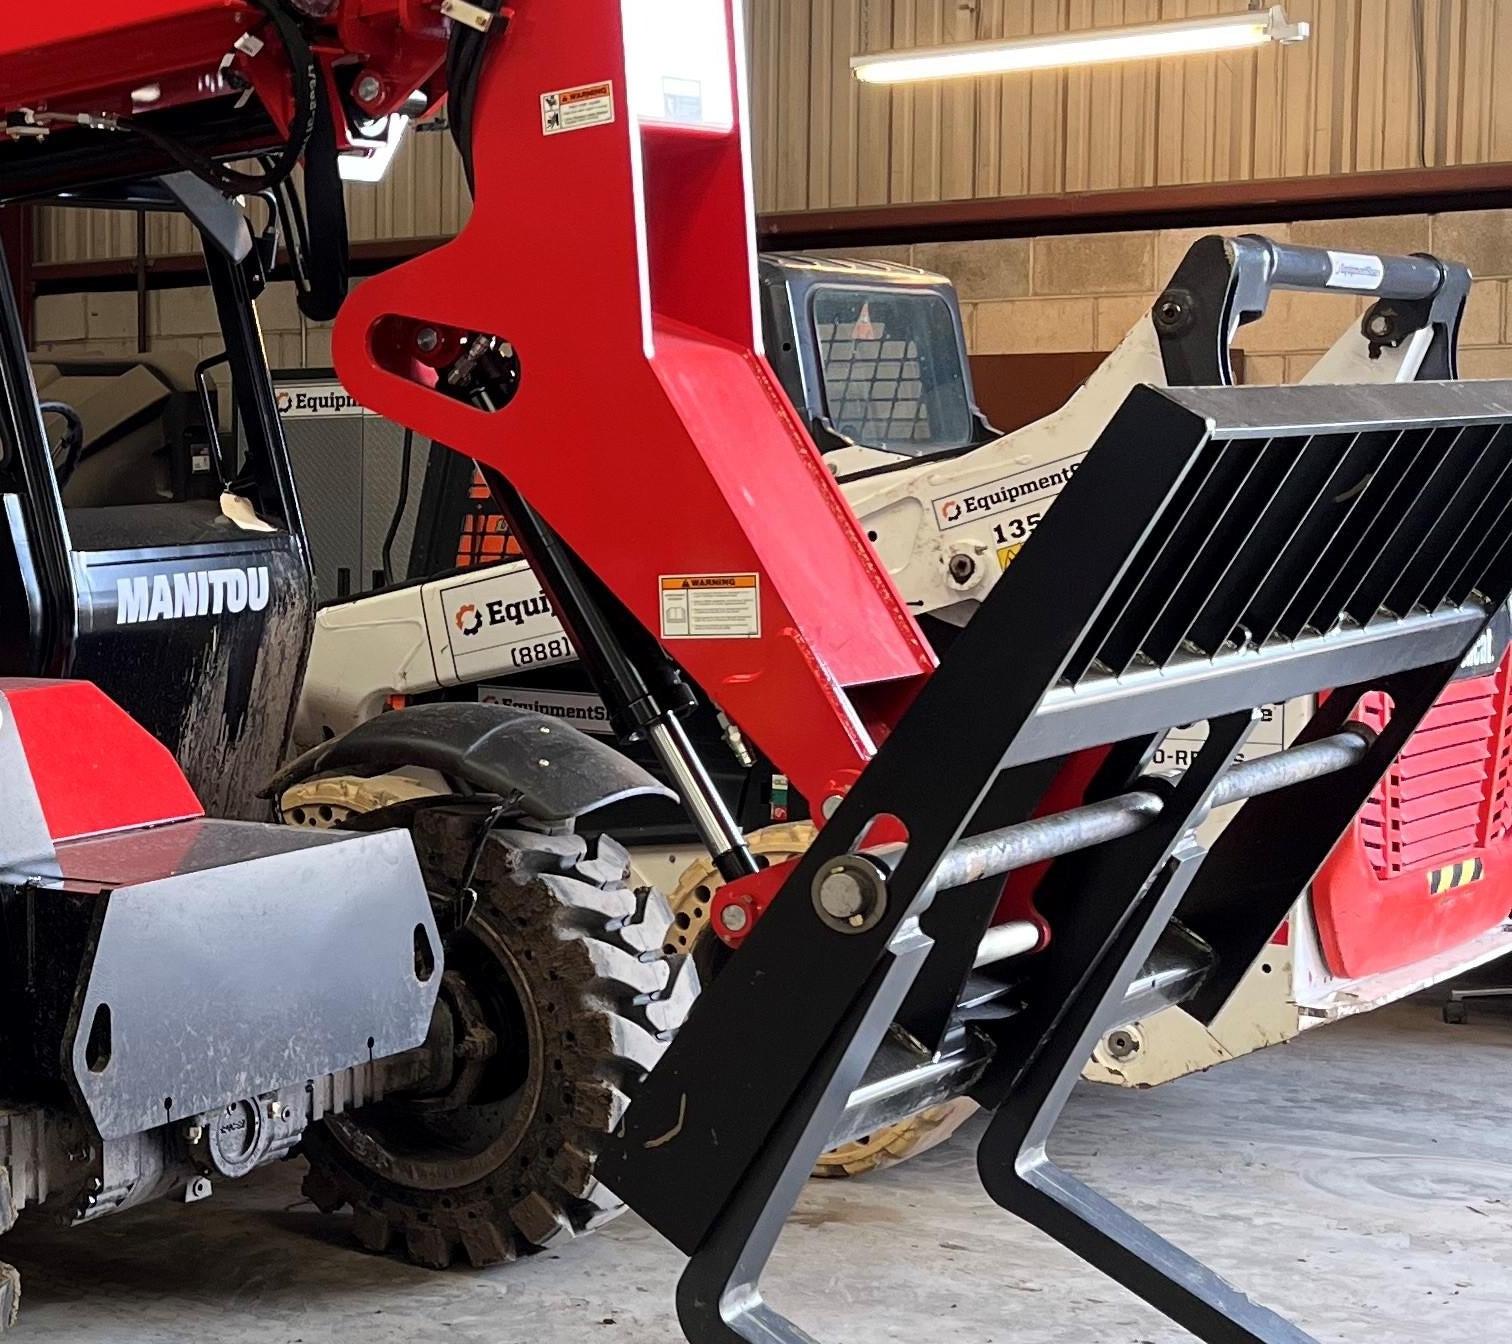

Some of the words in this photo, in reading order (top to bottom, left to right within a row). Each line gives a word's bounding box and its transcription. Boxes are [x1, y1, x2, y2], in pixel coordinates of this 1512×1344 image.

[116, 566, 270, 625] MANITOU
[691, 578, 736, 587] WARNING
[485, 589, 556, 626] Equi
[511, 636, 572, 668] (888)
